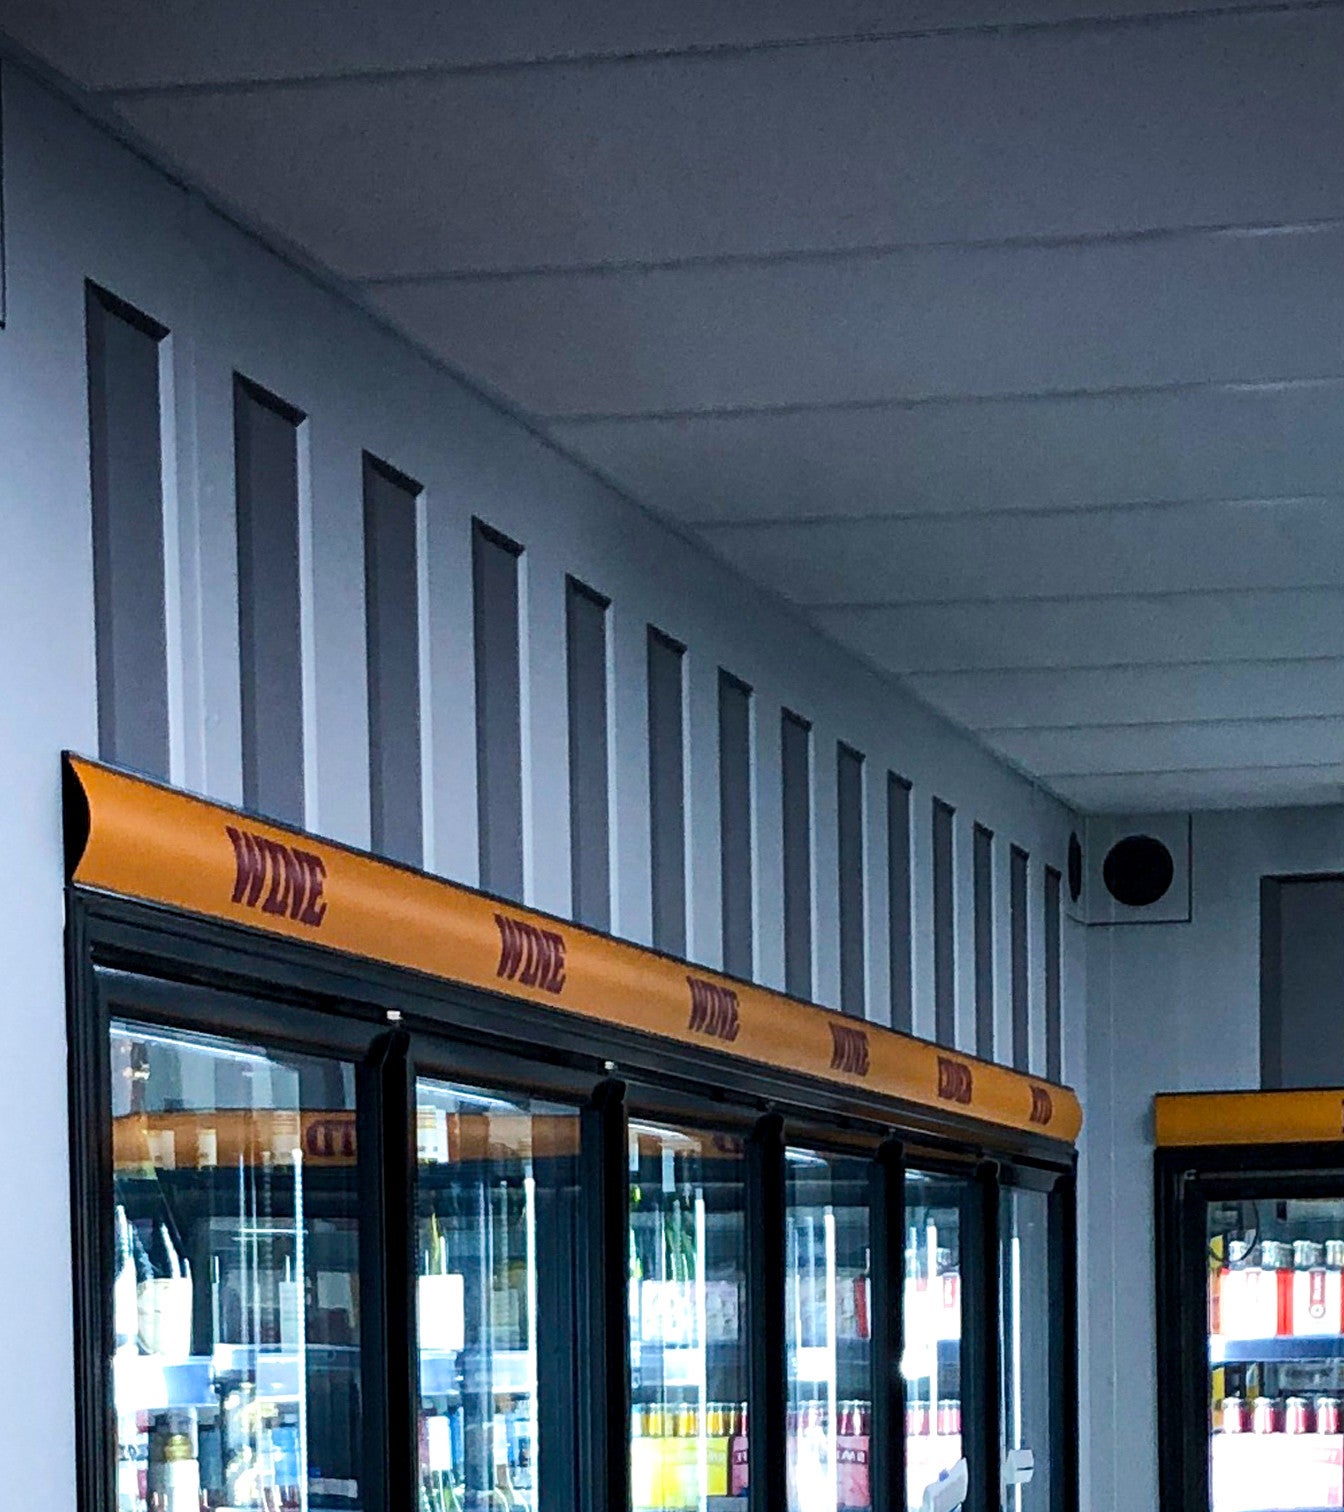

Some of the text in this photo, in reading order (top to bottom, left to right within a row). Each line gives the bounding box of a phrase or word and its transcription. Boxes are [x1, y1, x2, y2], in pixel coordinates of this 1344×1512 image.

[226, 826, 328, 928] WINE
[493, 913, 567, 995] WINE
[686, 976, 740, 1042] WINE
